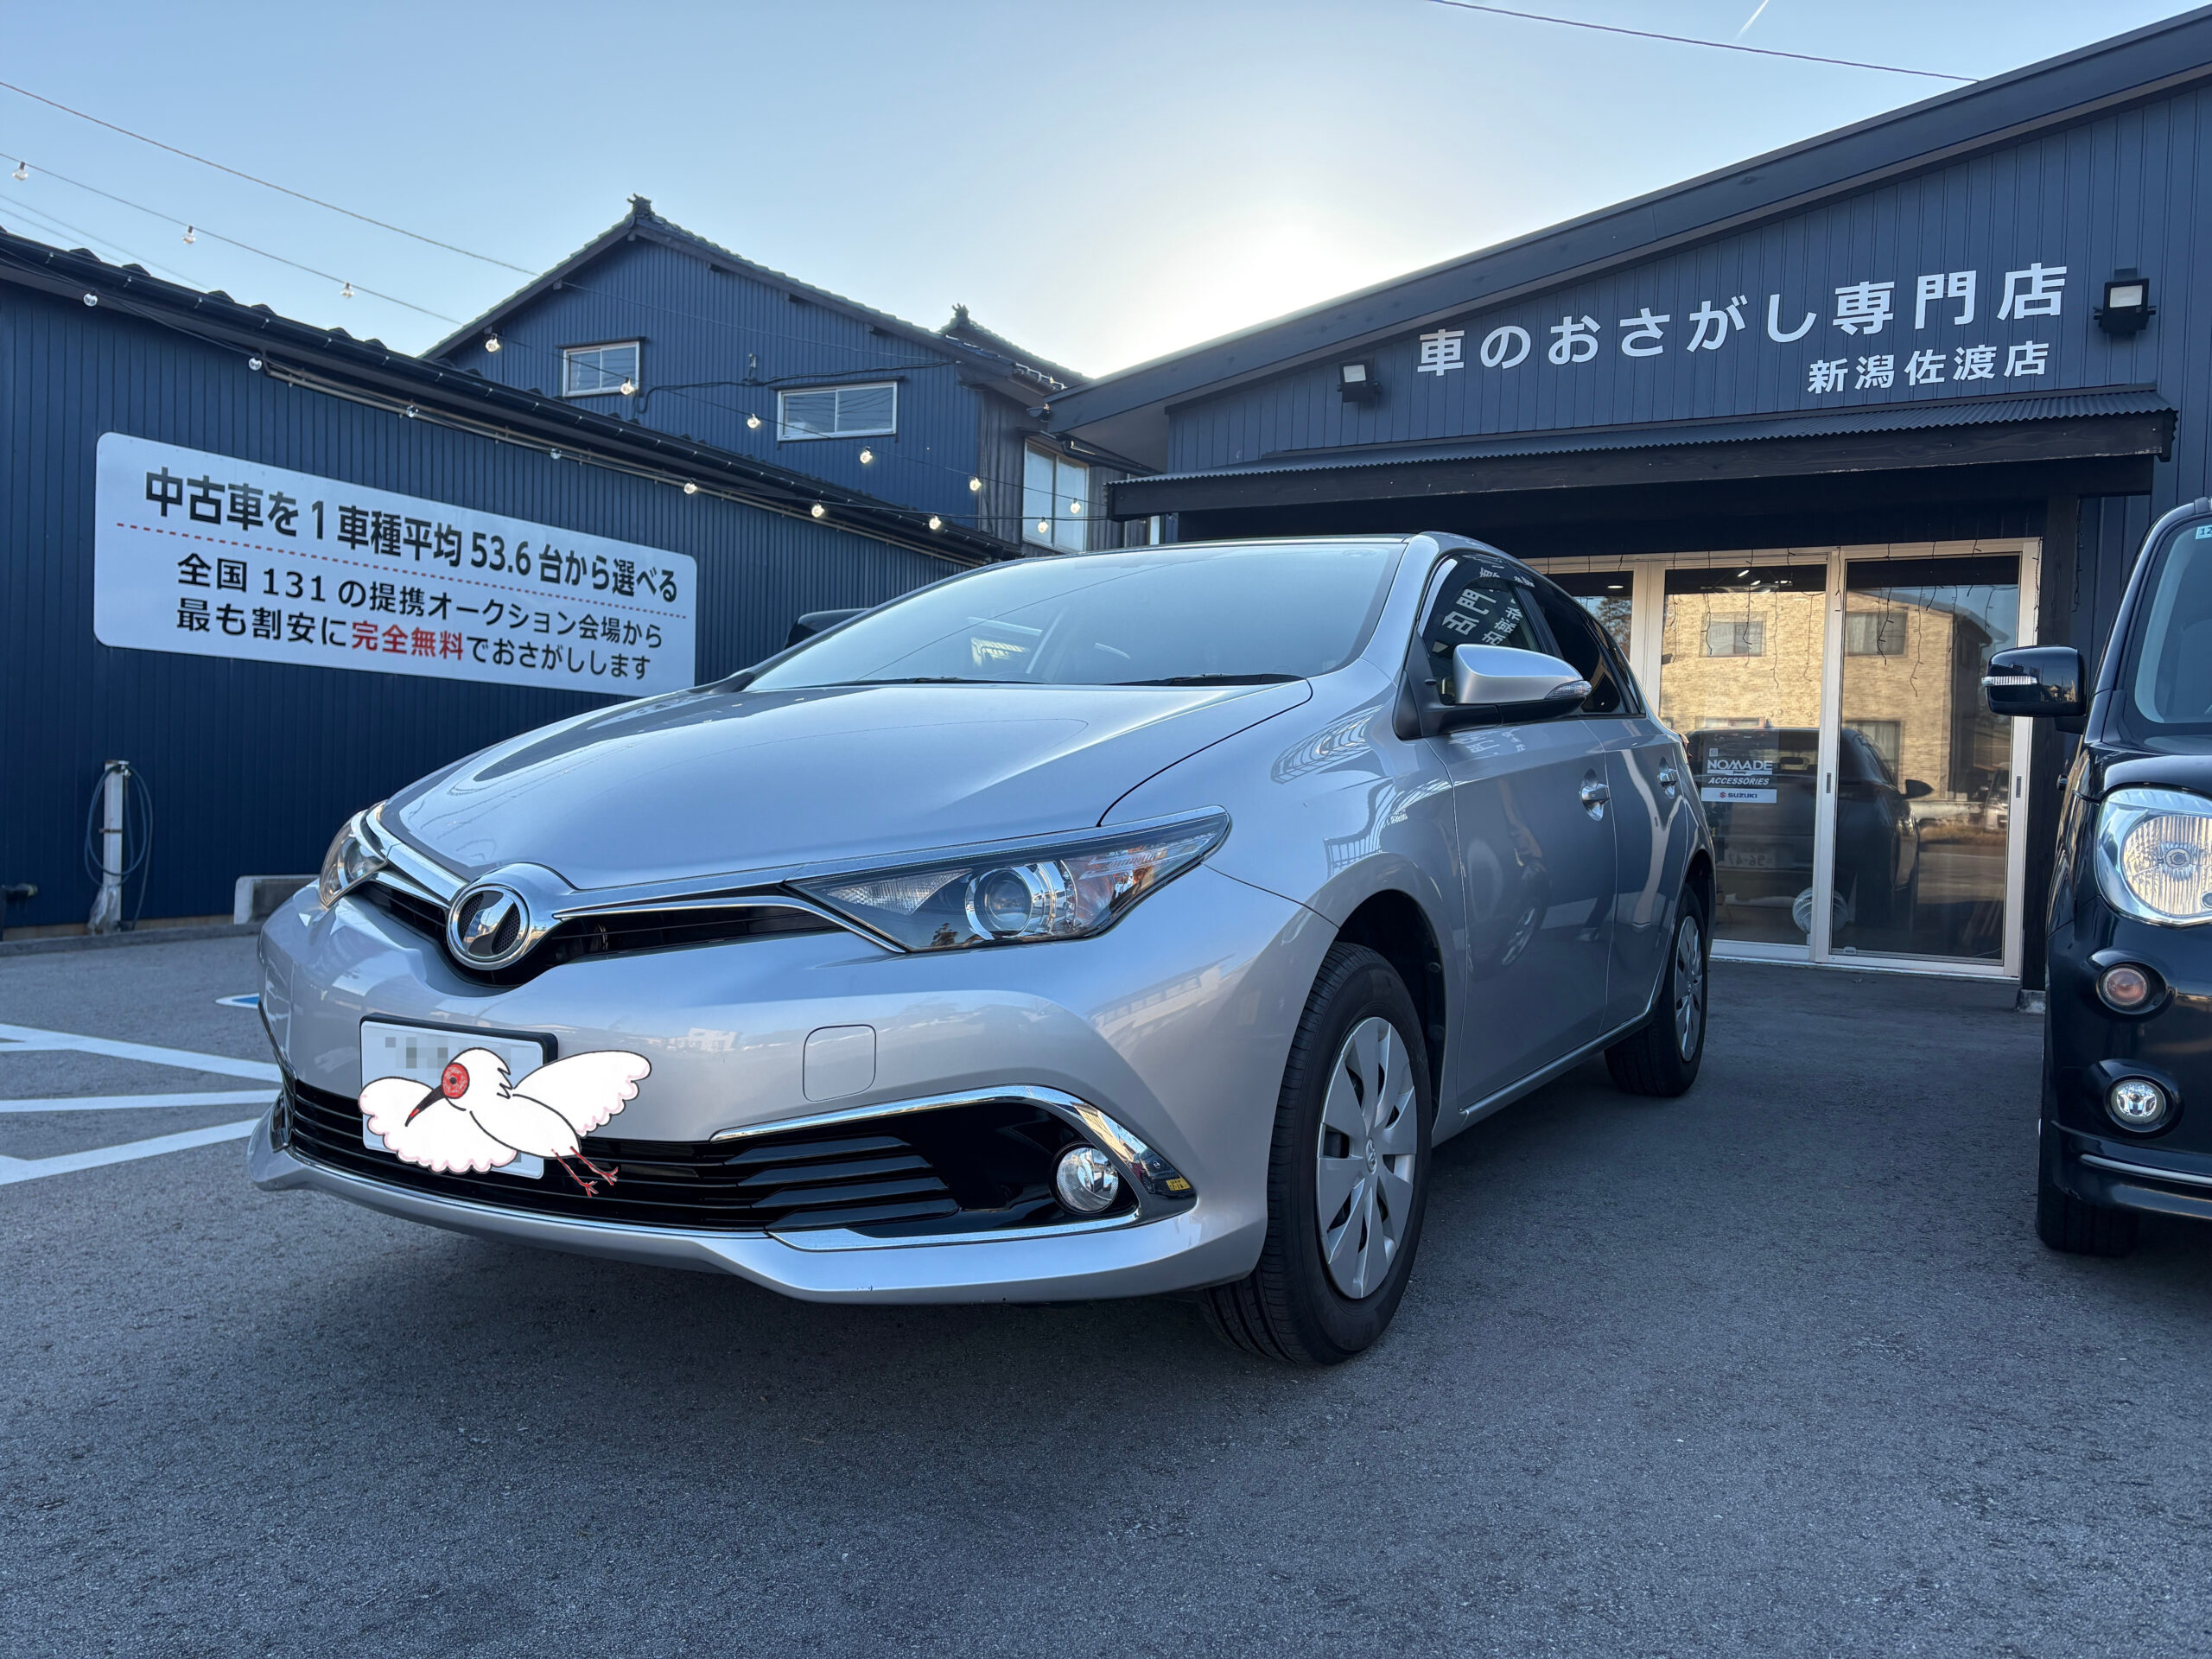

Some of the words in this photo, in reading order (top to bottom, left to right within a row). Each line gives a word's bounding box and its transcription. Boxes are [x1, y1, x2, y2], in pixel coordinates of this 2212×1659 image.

[1417, 262, 2067, 377] 車のおさがし専門店
[1808, 341, 2050, 395] 新潟佐渡店
[1707, 760, 1772, 770] NOMADE
[1708, 777, 1770, 785] ACCESSORIES
